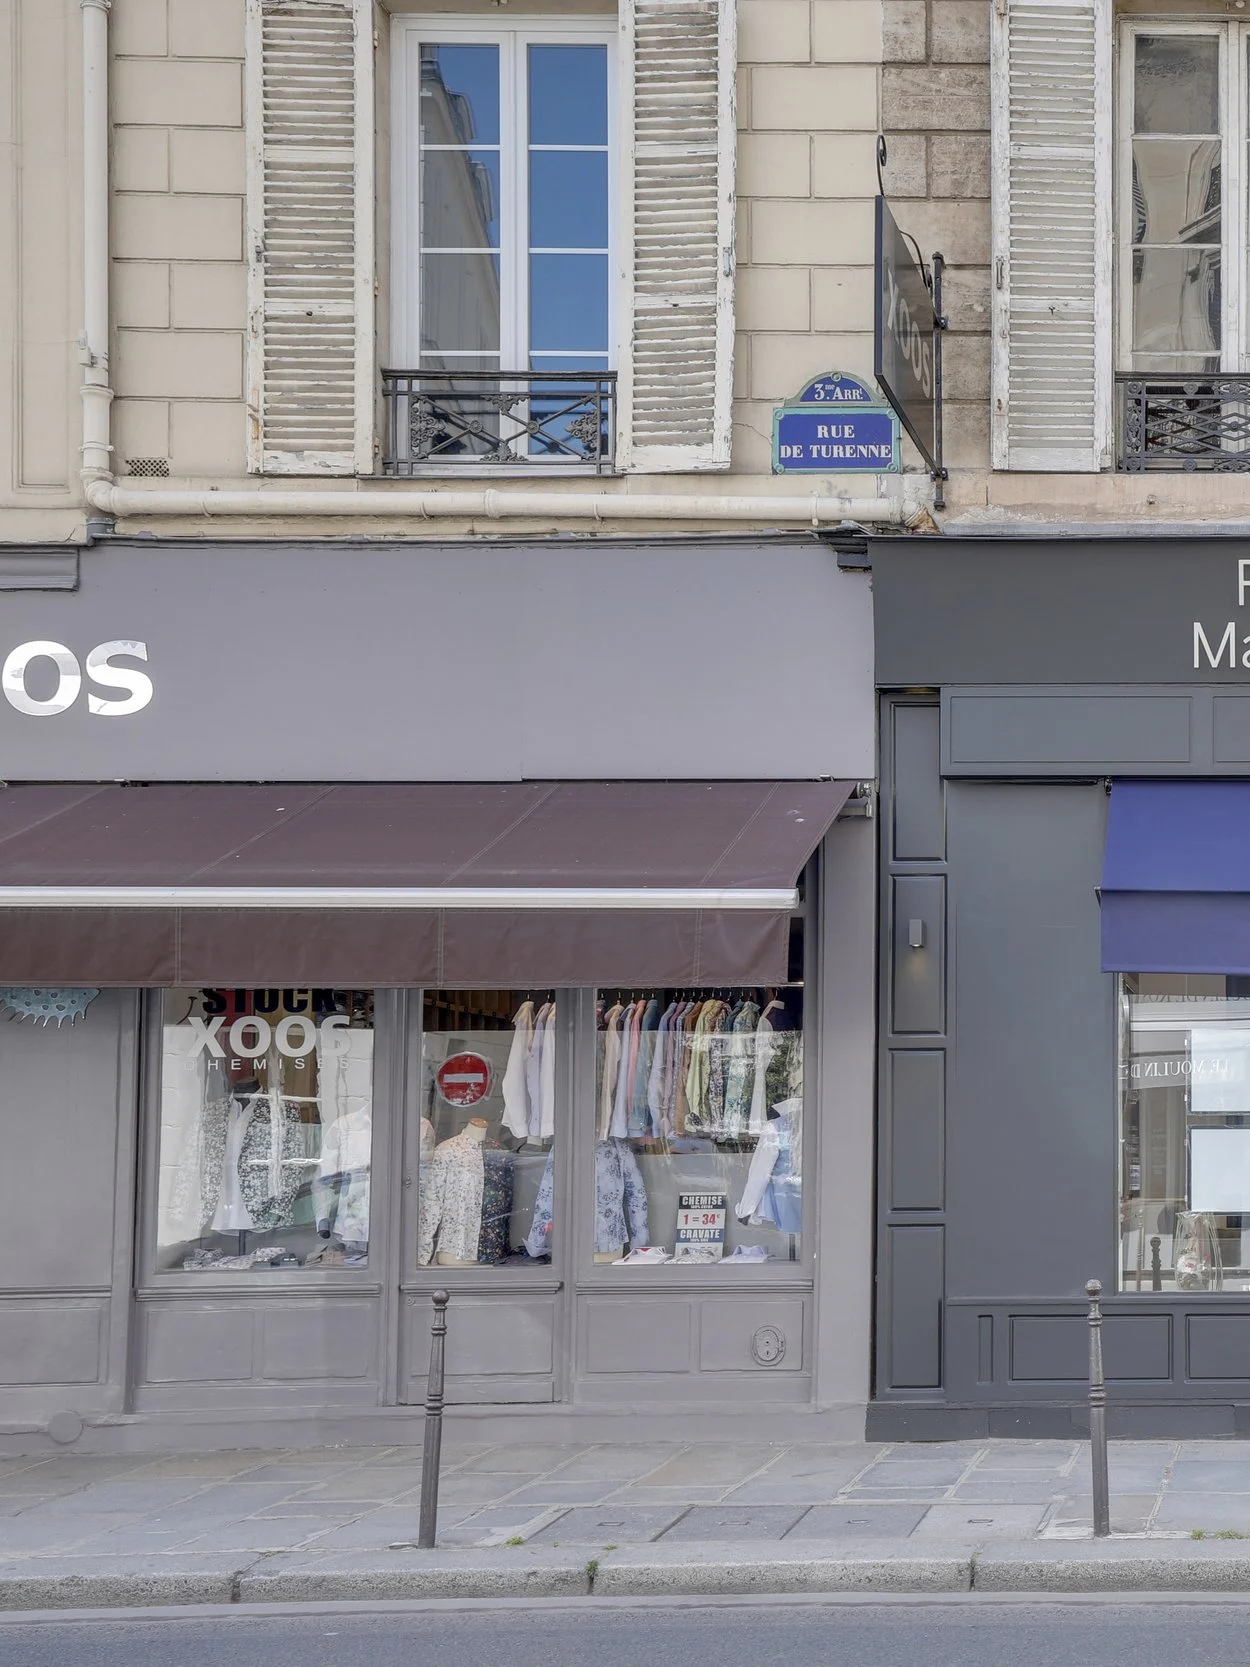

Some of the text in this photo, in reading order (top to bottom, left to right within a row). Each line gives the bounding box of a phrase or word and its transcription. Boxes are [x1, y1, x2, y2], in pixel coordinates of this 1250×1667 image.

[887, 268, 931, 399] XOOS
[817, 425, 855, 439] RUE
[780, 445, 892, 458] DE TURENNE
[2, 639, 154, 717] OS
[186, 1015, 352, 1059] XOOS
[682, 1196, 722, 1205] CHEMISE
[683, 1214, 689, 1225] 1
[680, 1229, 720, 1239] CRAVATE
